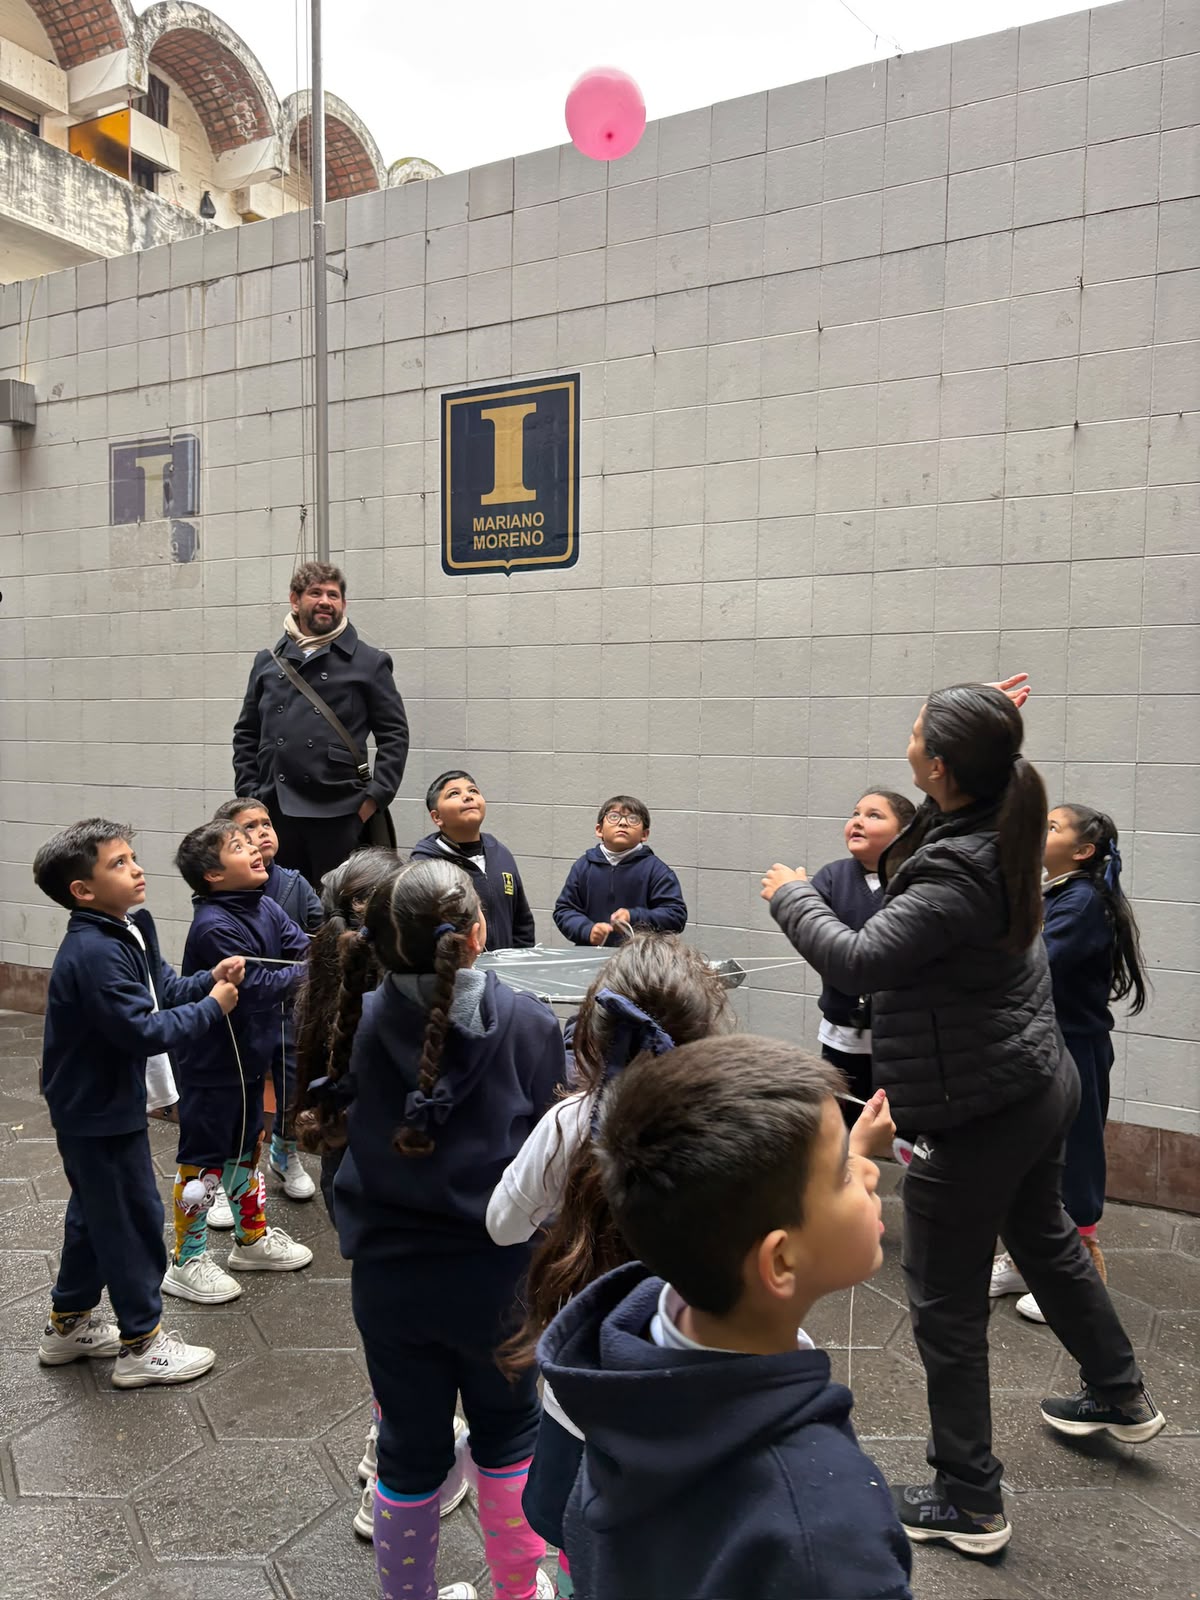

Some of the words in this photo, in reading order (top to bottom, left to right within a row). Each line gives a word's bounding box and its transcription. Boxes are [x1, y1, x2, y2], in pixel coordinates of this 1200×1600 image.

[481, 402, 537, 505] I
[473, 511, 545, 532] MARIANO
[473, 530, 544, 550] MORENO
[150, 1357, 169, 1367] FILA
[919, 1504, 959, 1522] FILA
